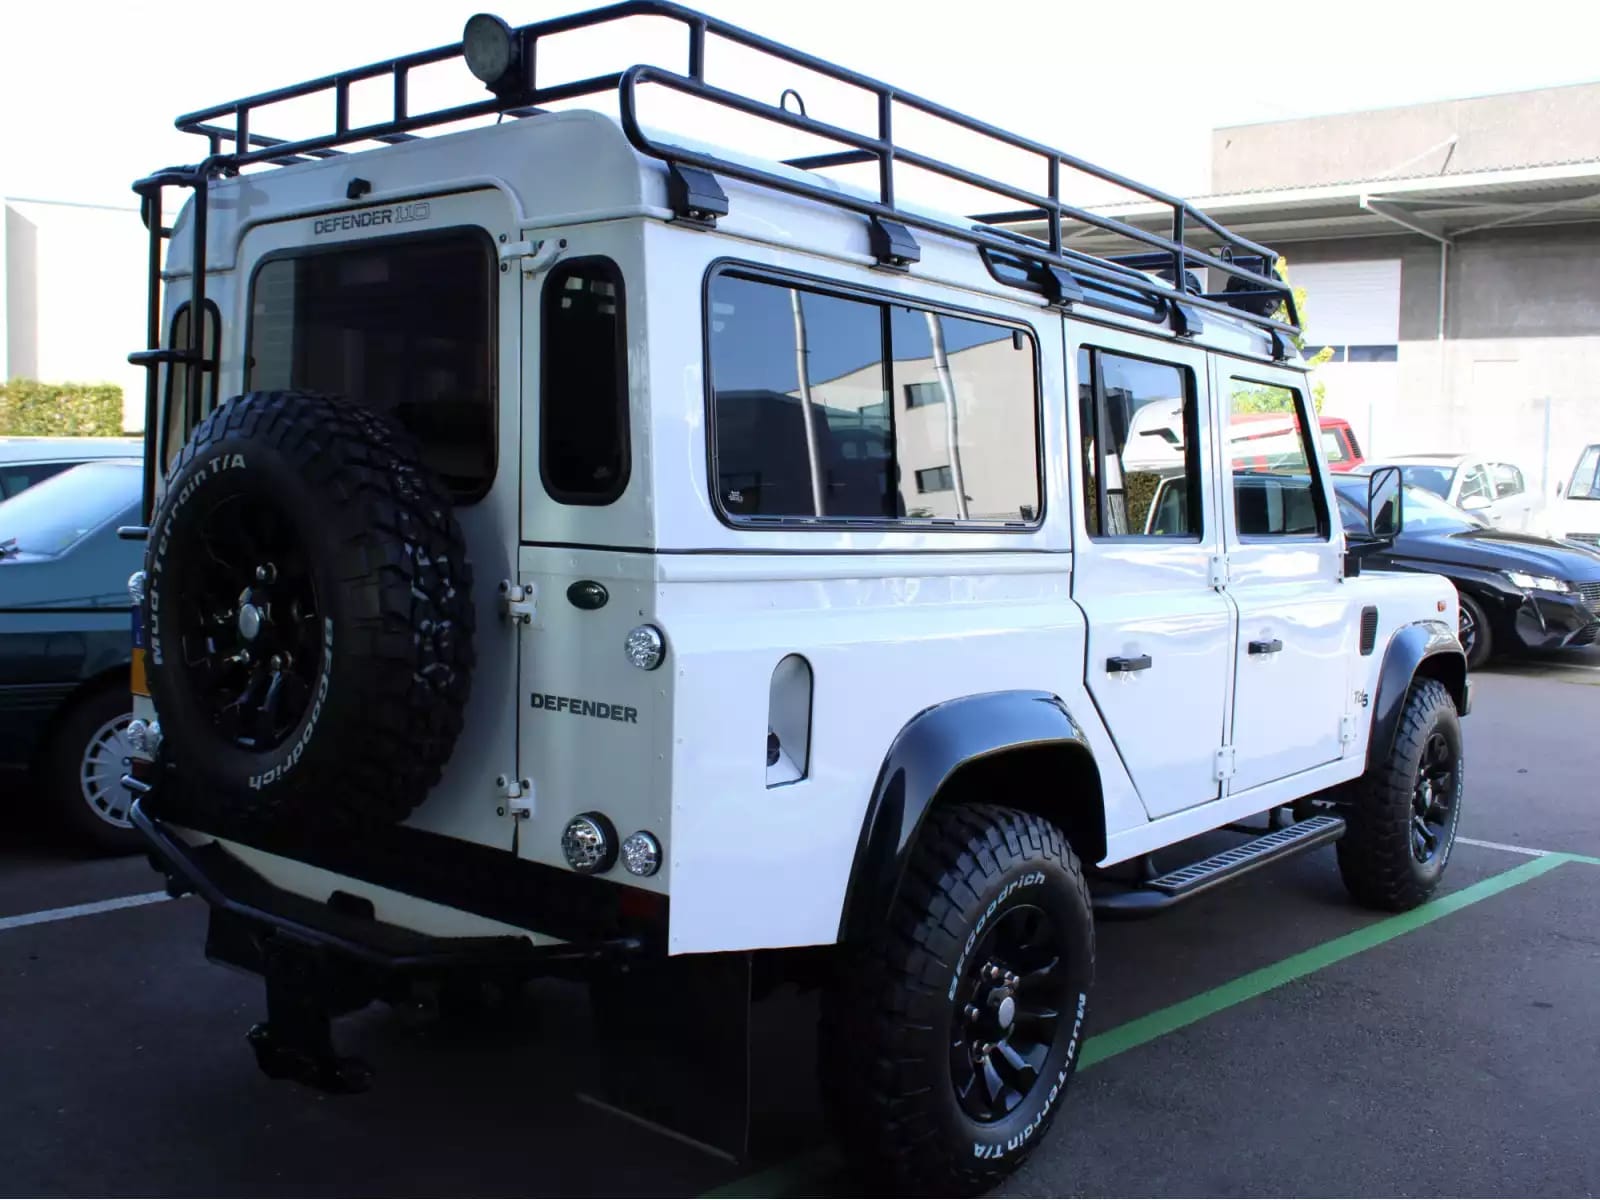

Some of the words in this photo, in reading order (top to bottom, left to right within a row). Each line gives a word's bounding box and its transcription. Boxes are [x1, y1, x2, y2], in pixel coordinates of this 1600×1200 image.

[314, 208, 392, 235] DEFENDER
[395, 202, 431, 223] 110
[150, 469, 208, 665] Mud-Terrain
[209, 453, 247, 473] T/A
[249, 616, 334, 790] BFGoodrich
[530, 692, 638, 724] DEFENDER
[948, 871, 1046, 1001] BFGoodrich
[1007, 993, 1087, 1152] Mud-Terrain
[973, 1143, 1004, 1160] T/A
